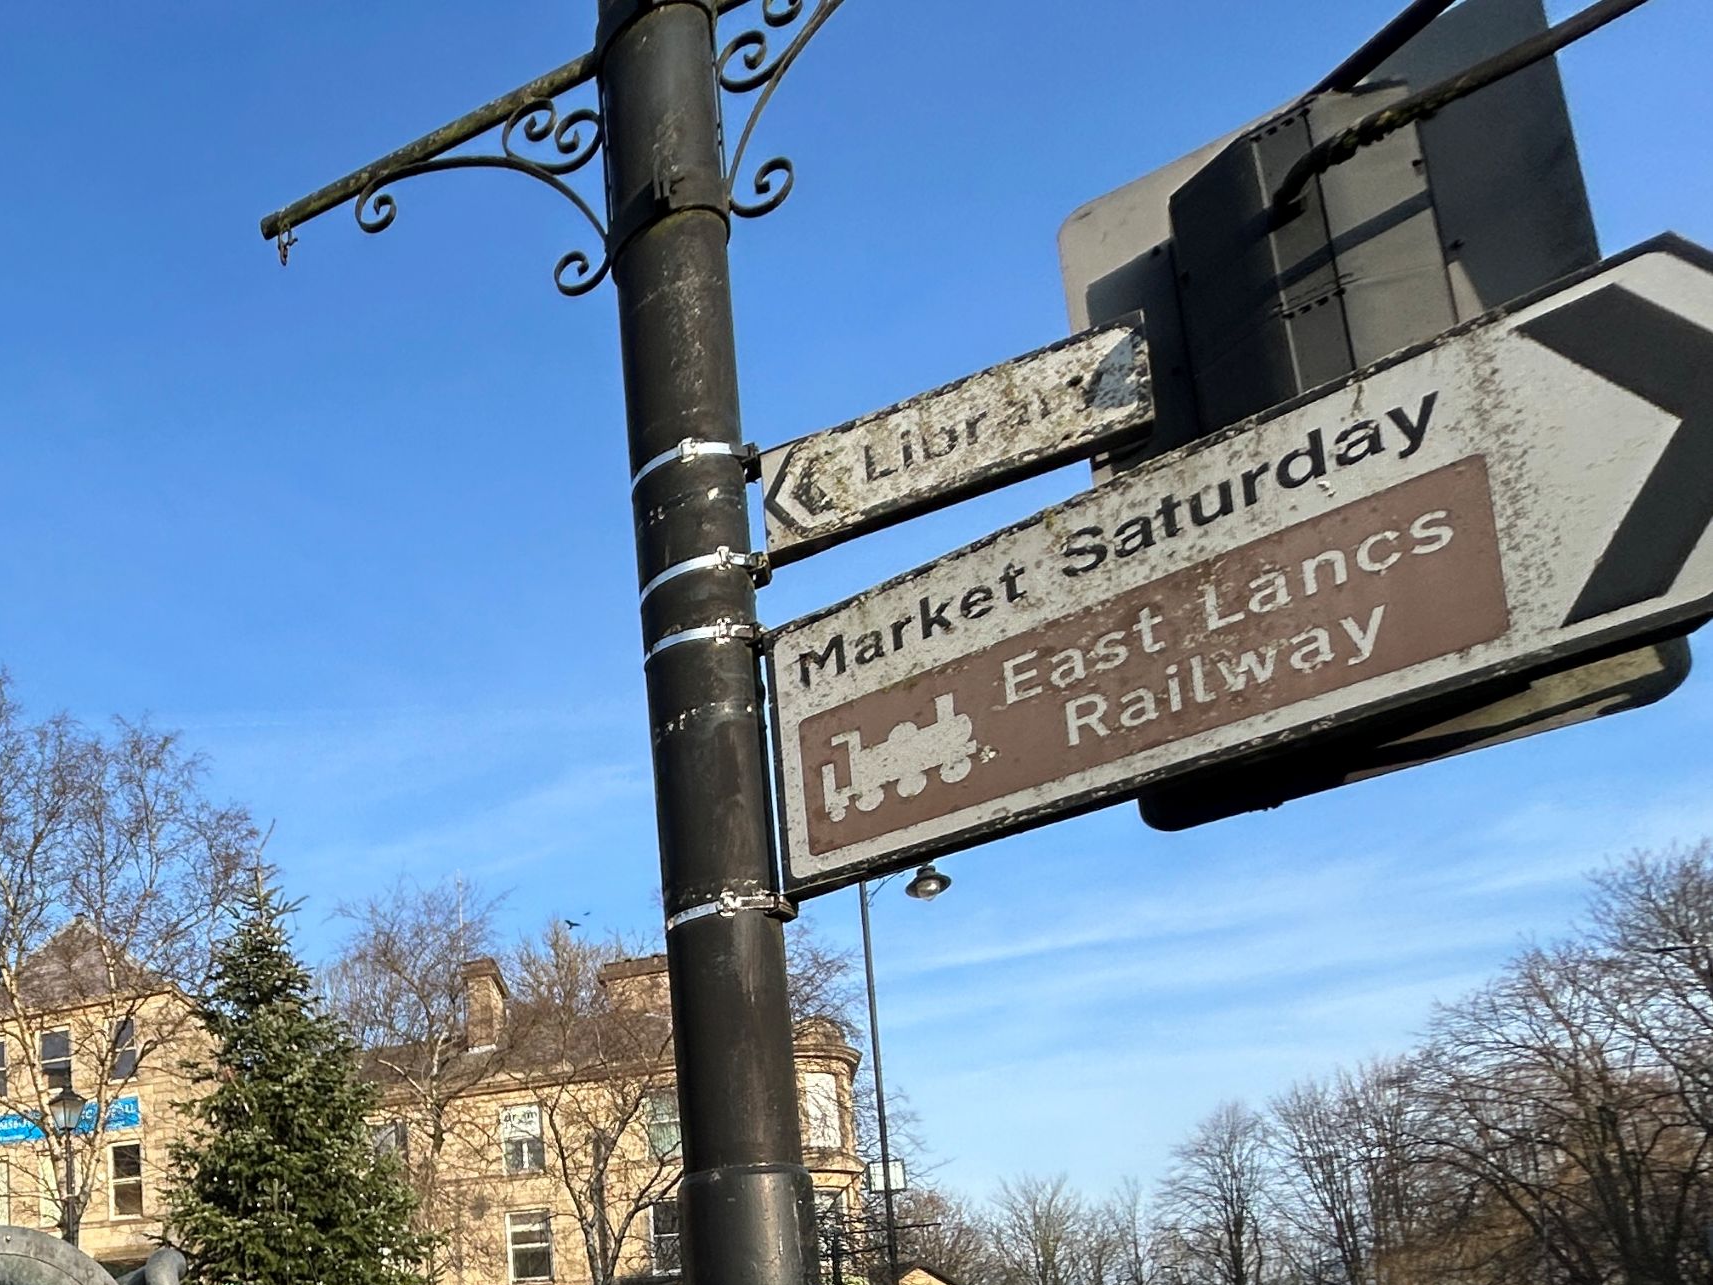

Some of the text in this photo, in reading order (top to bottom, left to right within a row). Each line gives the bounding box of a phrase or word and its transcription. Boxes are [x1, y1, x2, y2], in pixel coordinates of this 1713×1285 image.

[796, 390, 1440, 689] Market Saturday
[1002, 509, 1455, 705] East Lancs
[1064, 602, 1386, 747] Railway
